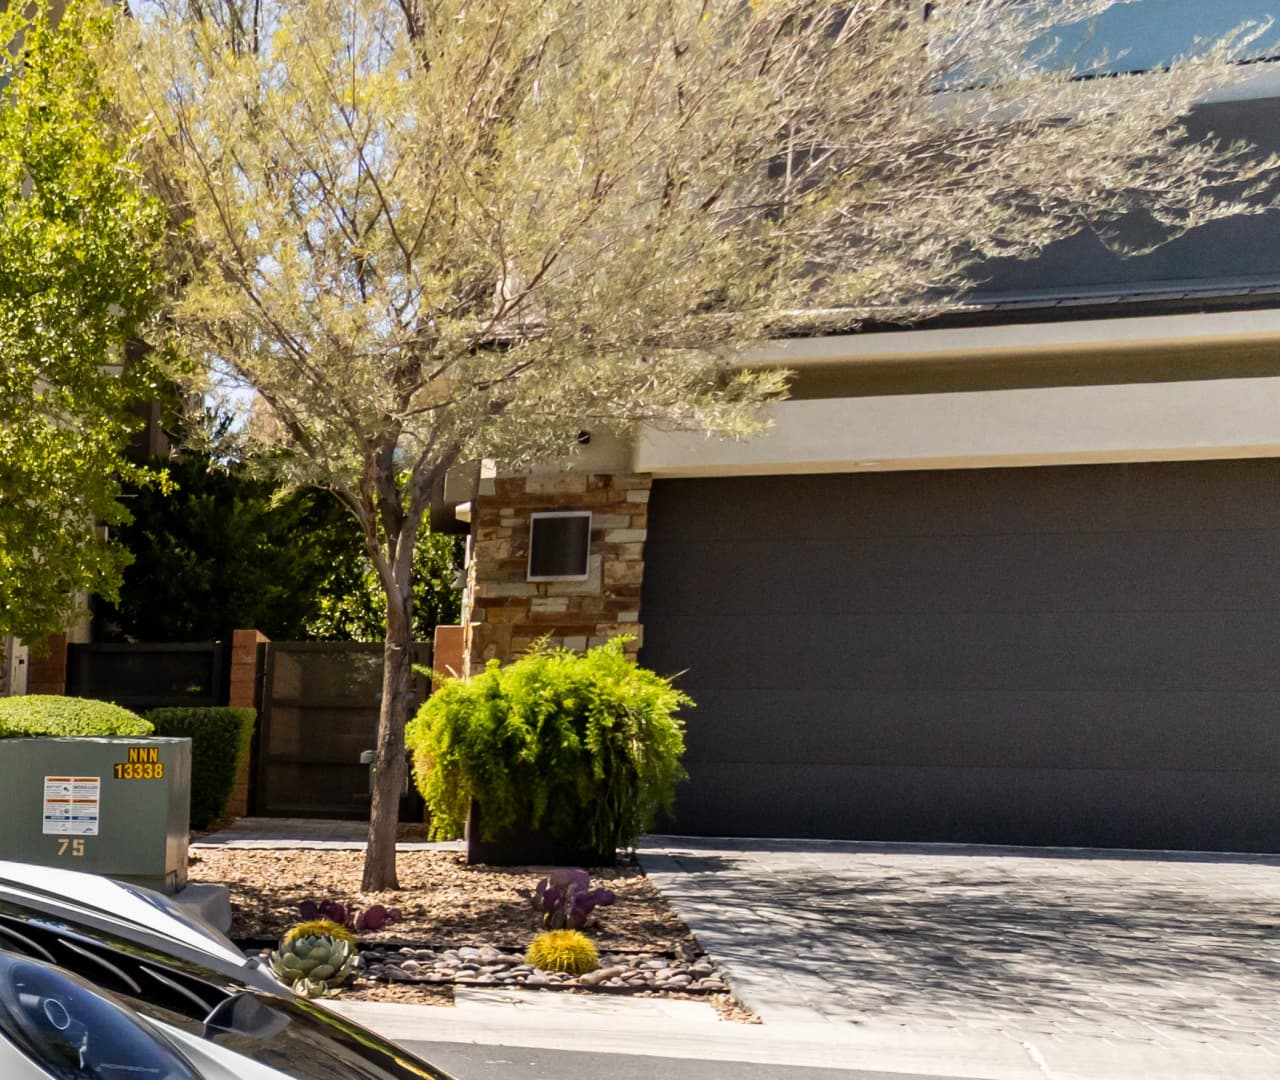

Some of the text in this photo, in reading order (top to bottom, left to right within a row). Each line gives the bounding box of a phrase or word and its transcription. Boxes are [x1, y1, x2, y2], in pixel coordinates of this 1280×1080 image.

[129, 747, 158, 762] NNN
[115, 763, 163, 779] 13338
[57, 838, 85, 856] 75
